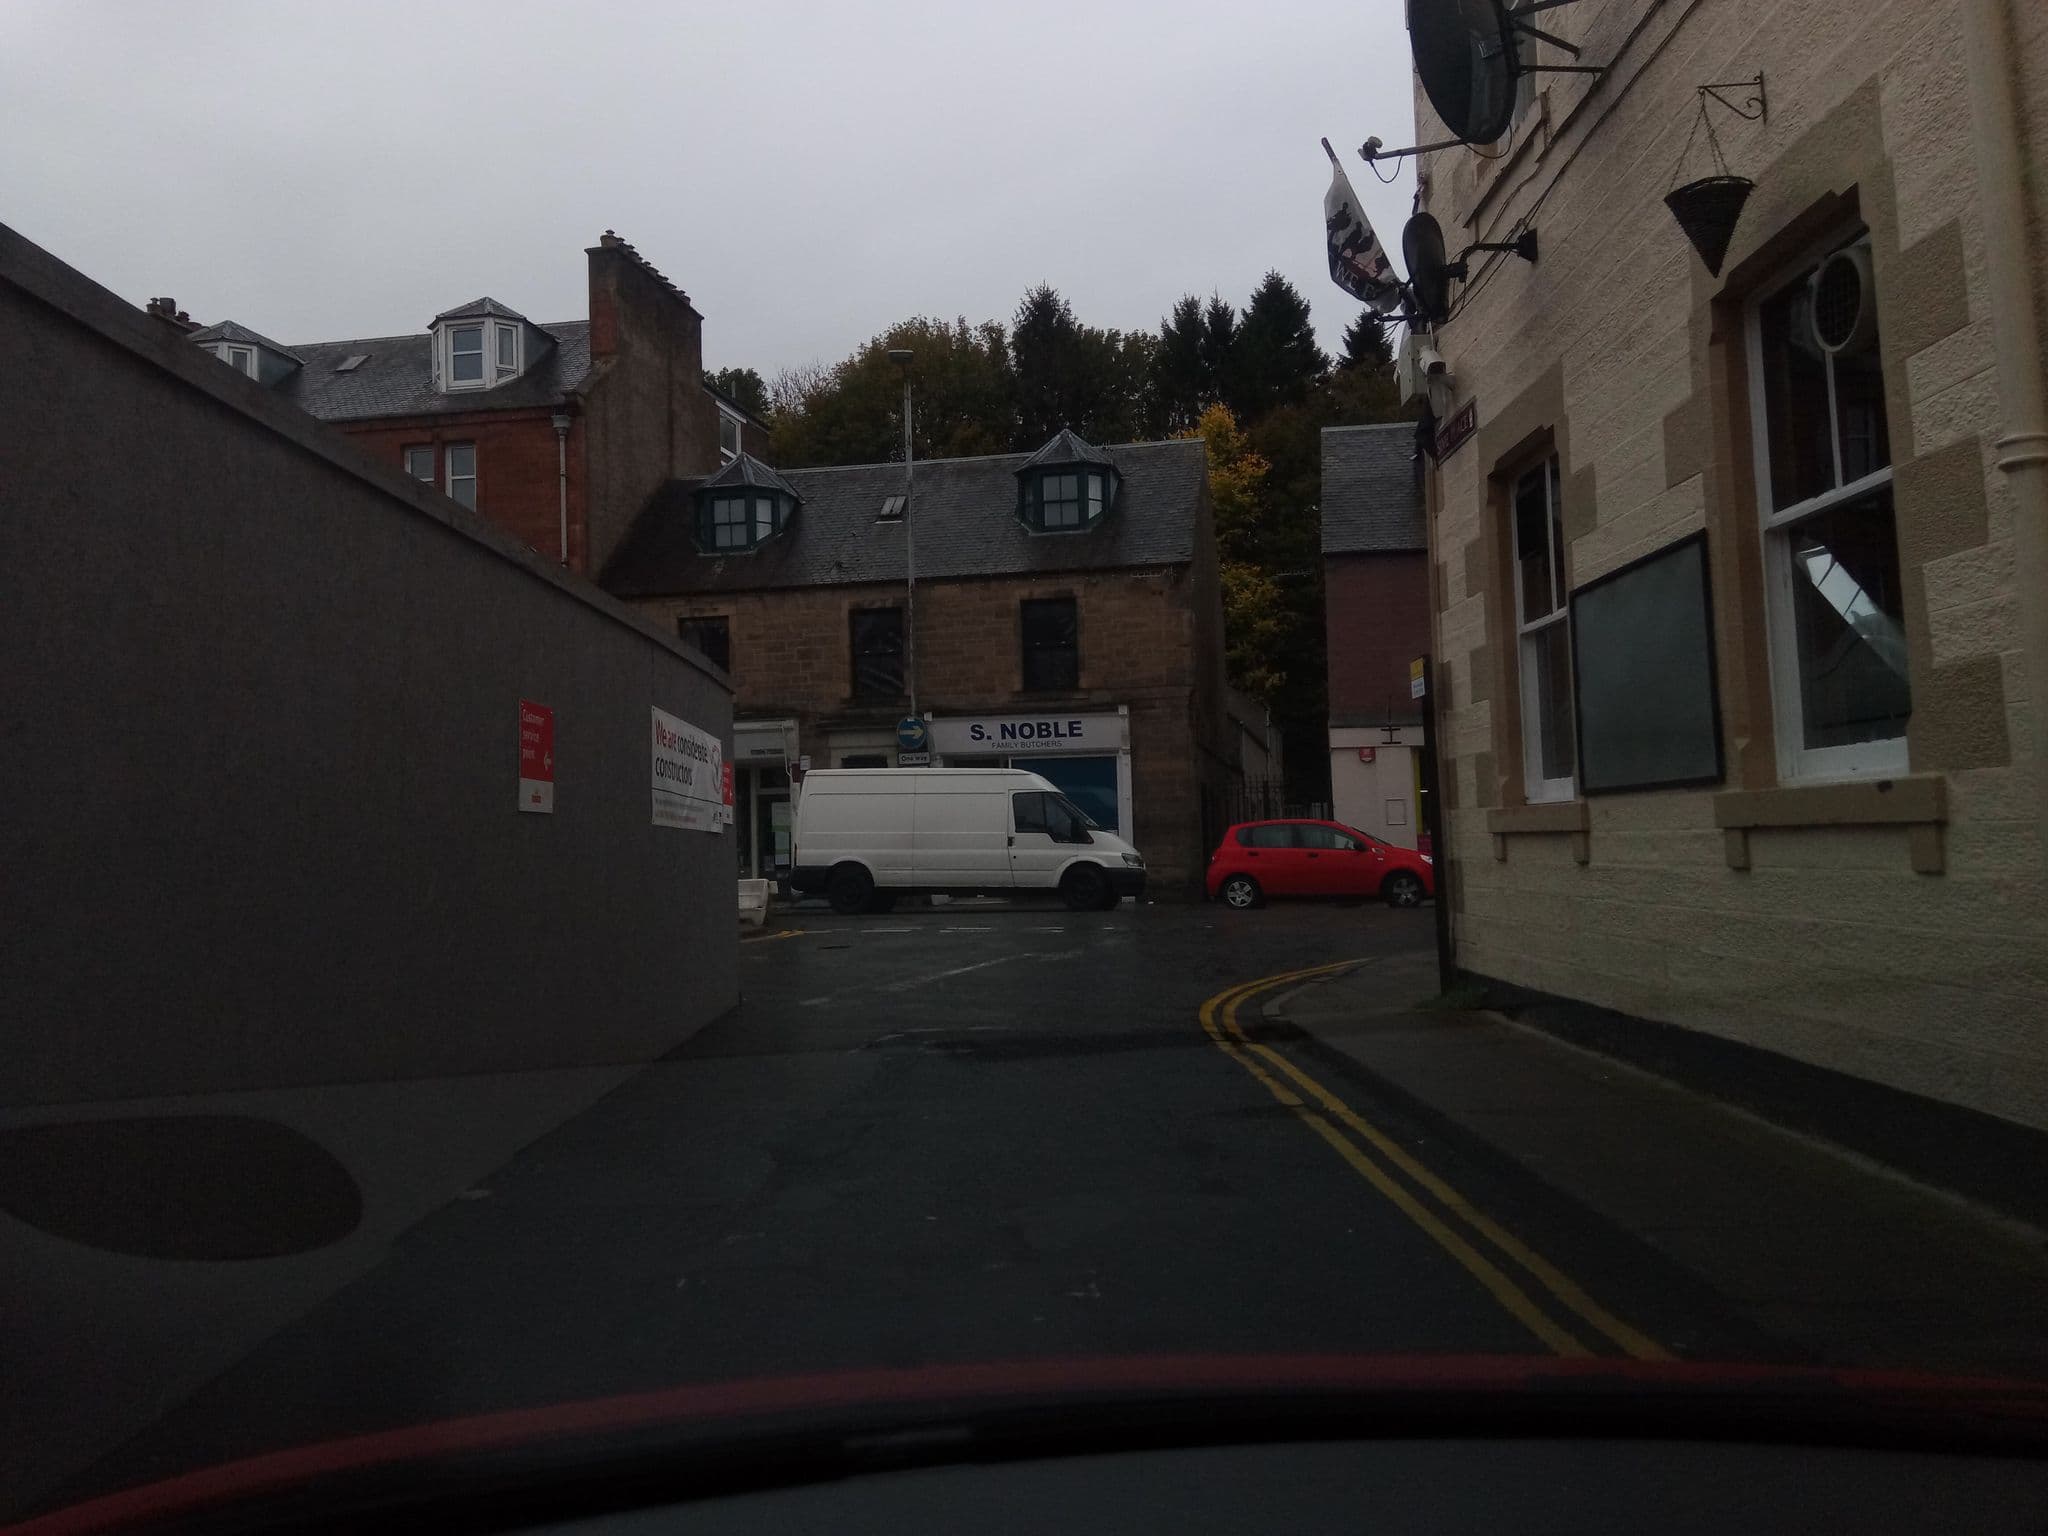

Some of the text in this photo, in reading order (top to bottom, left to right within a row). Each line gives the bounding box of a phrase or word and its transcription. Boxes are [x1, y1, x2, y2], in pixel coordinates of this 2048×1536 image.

[655, 719, 708, 764] We are considerate
[970, 720, 1083, 741] S. NOBLE
[991, 740, 1062, 749] FAMILY BUTCHERS
[655, 757, 693, 786] constructors
